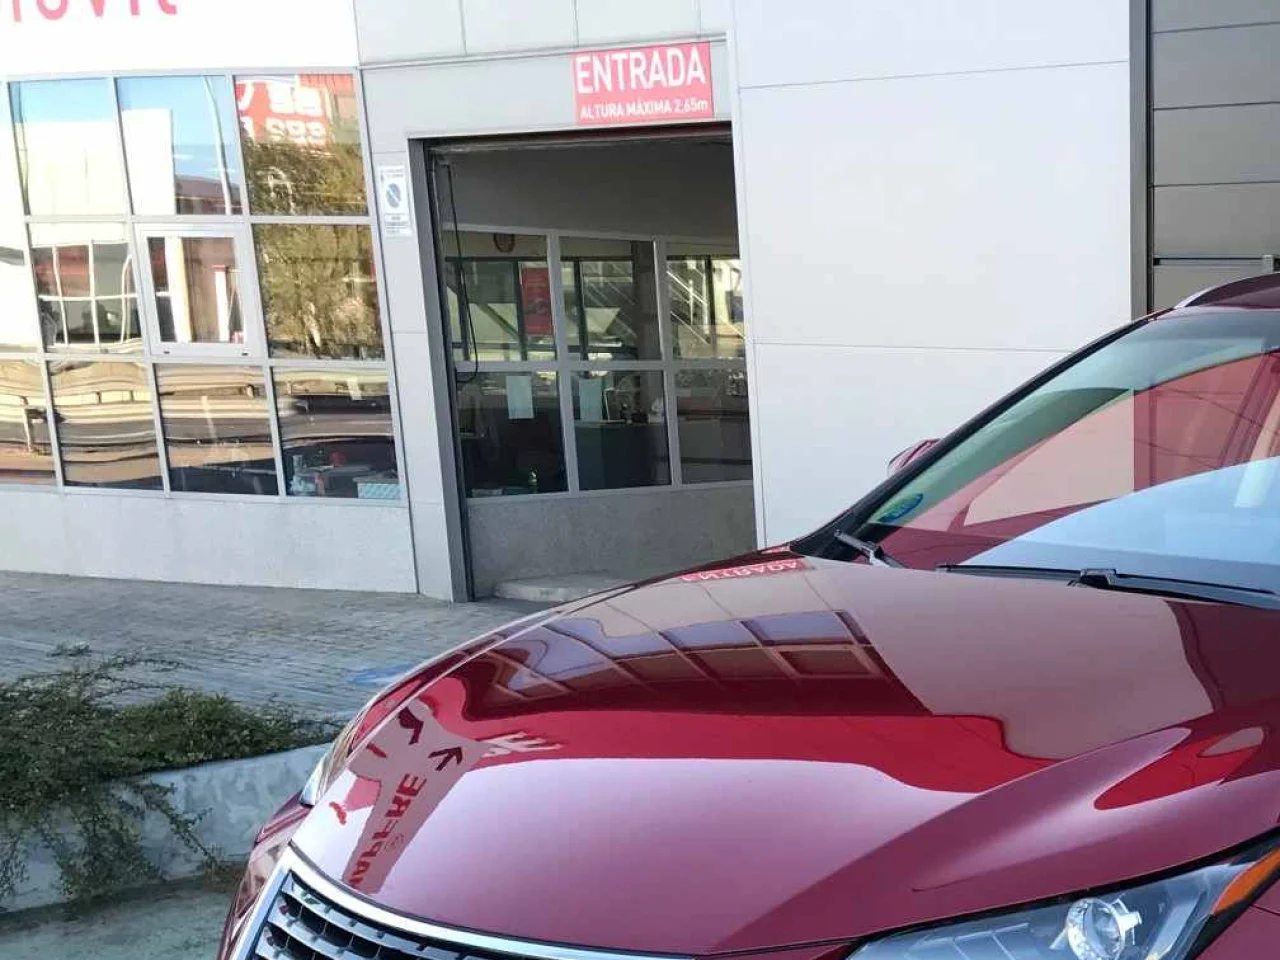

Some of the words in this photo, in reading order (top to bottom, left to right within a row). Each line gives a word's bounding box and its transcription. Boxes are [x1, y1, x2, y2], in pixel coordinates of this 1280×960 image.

[575, 47, 706, 94] ENTRADA
[580, 101, 625, 119] ALTURA
[626, 98, 672, 116] MÁXIMA
